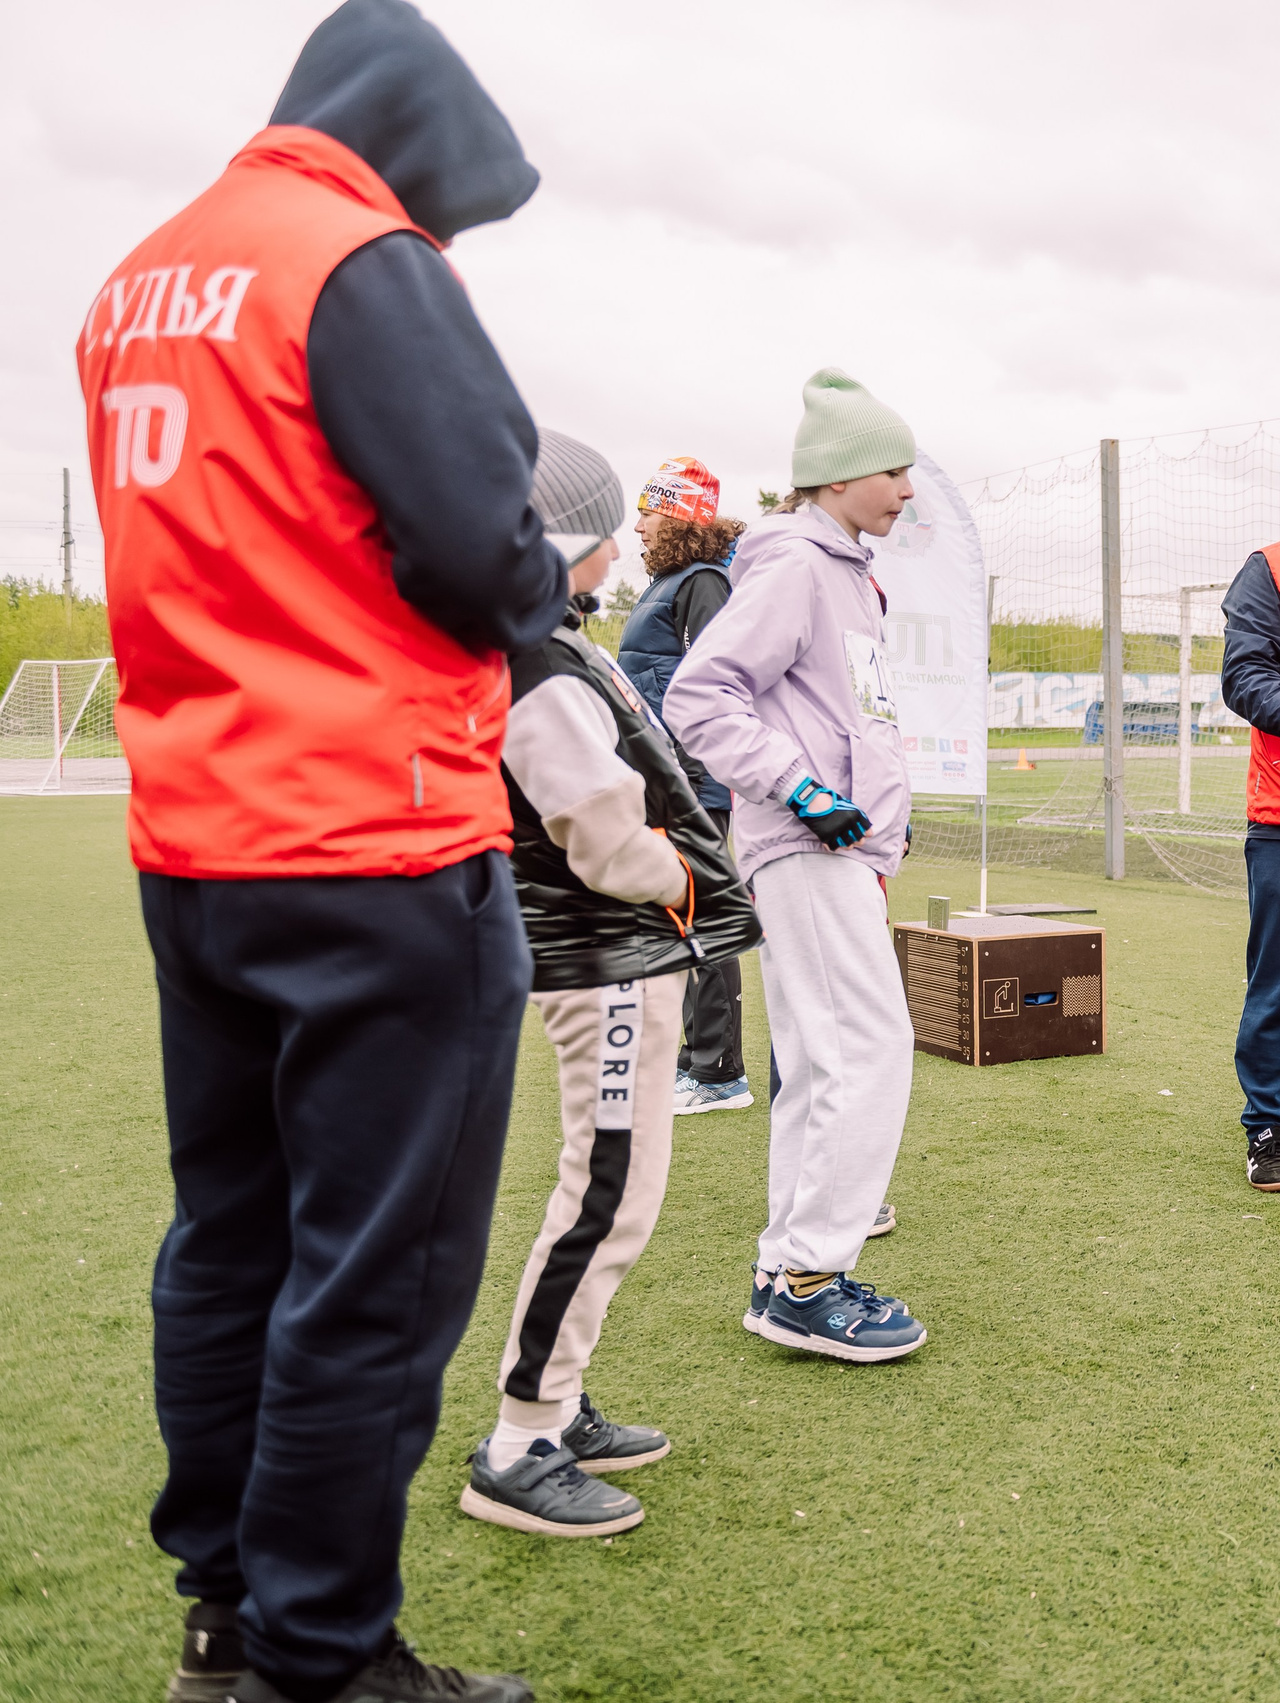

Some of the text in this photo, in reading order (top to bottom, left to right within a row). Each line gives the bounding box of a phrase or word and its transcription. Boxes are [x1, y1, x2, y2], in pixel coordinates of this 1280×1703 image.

[84, 264, 260, 357] СУДЬЯ
[961, 947, 966, 957] 5
[961, 965, 968, 975] 10
[961, 981, 969, 991] 15
[962, 998, 969, 1008] 20
[962, 1014, 970, 1024] 25
[962, 1030, 970, 1041] 30
[963, 1046, 971, 1057] 35
